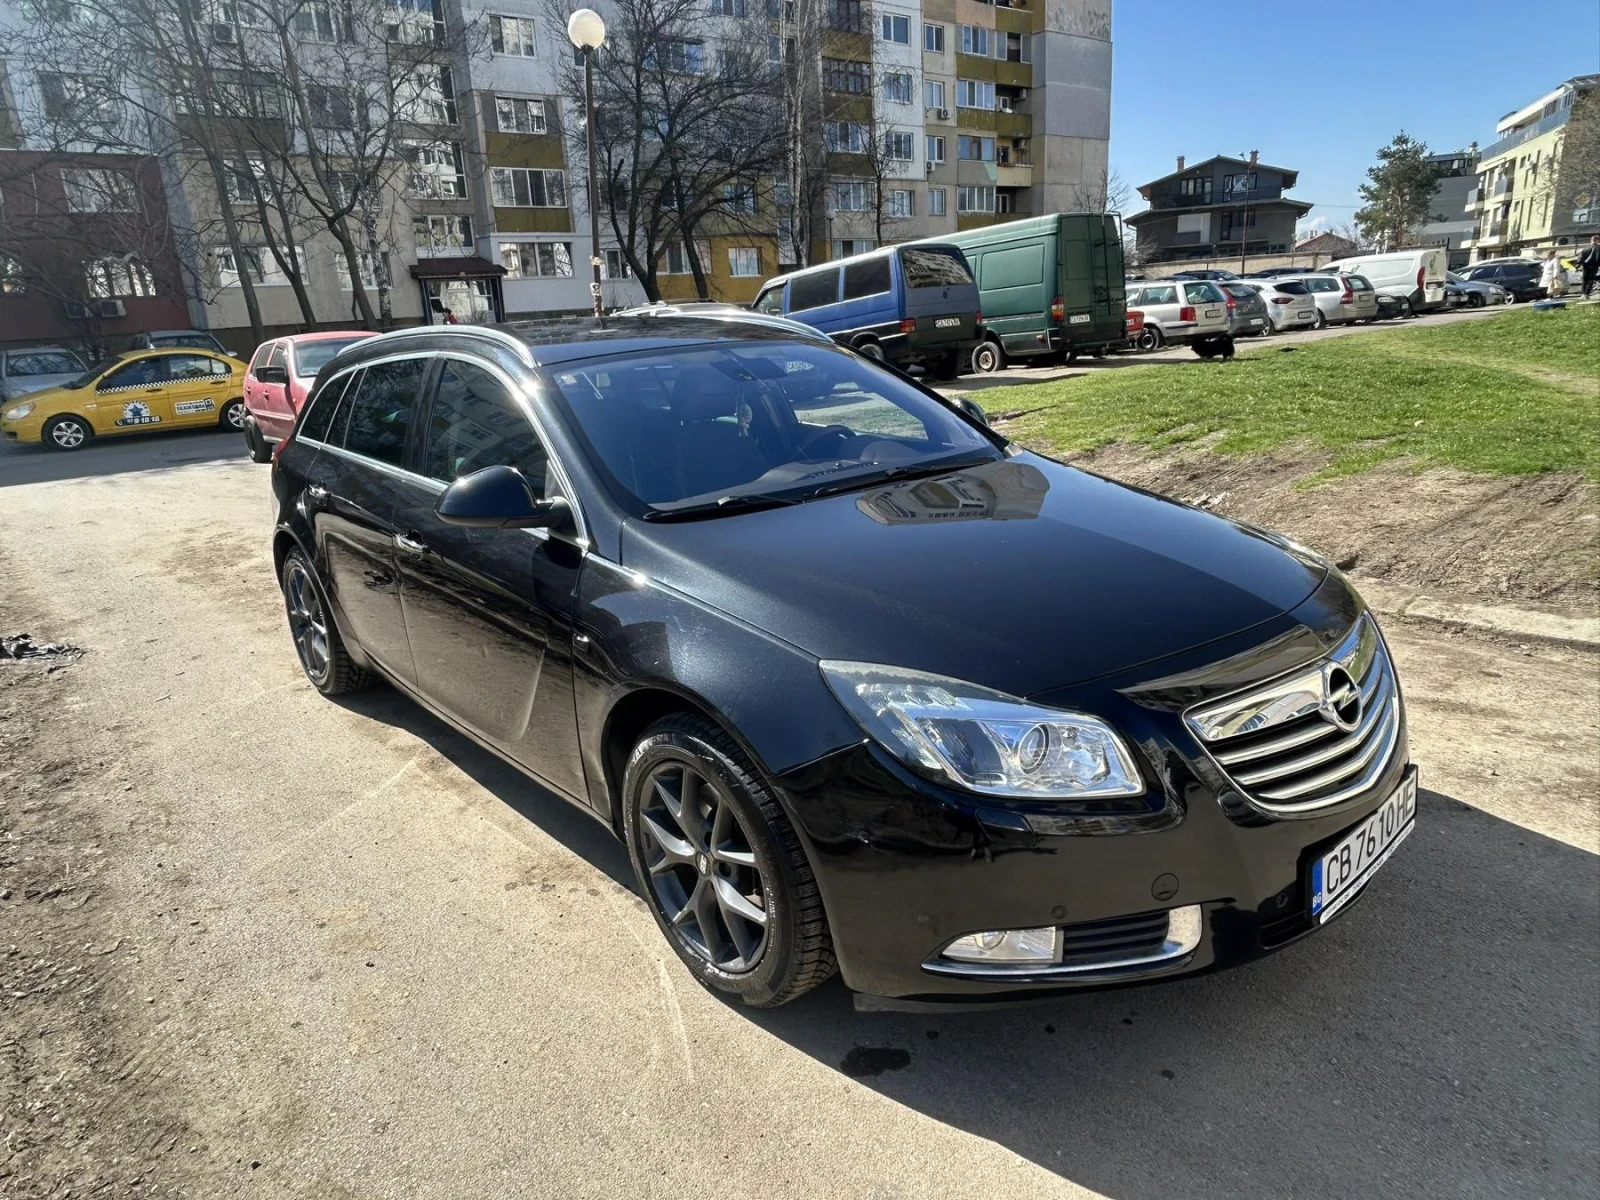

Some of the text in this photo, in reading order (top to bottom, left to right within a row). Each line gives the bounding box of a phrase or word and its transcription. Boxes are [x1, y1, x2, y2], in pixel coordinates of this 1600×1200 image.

[1326, 844, 1352, 894] CB
[1396, 777, 1415, 828] HE
[1312, 891, 1322, 909] BG
